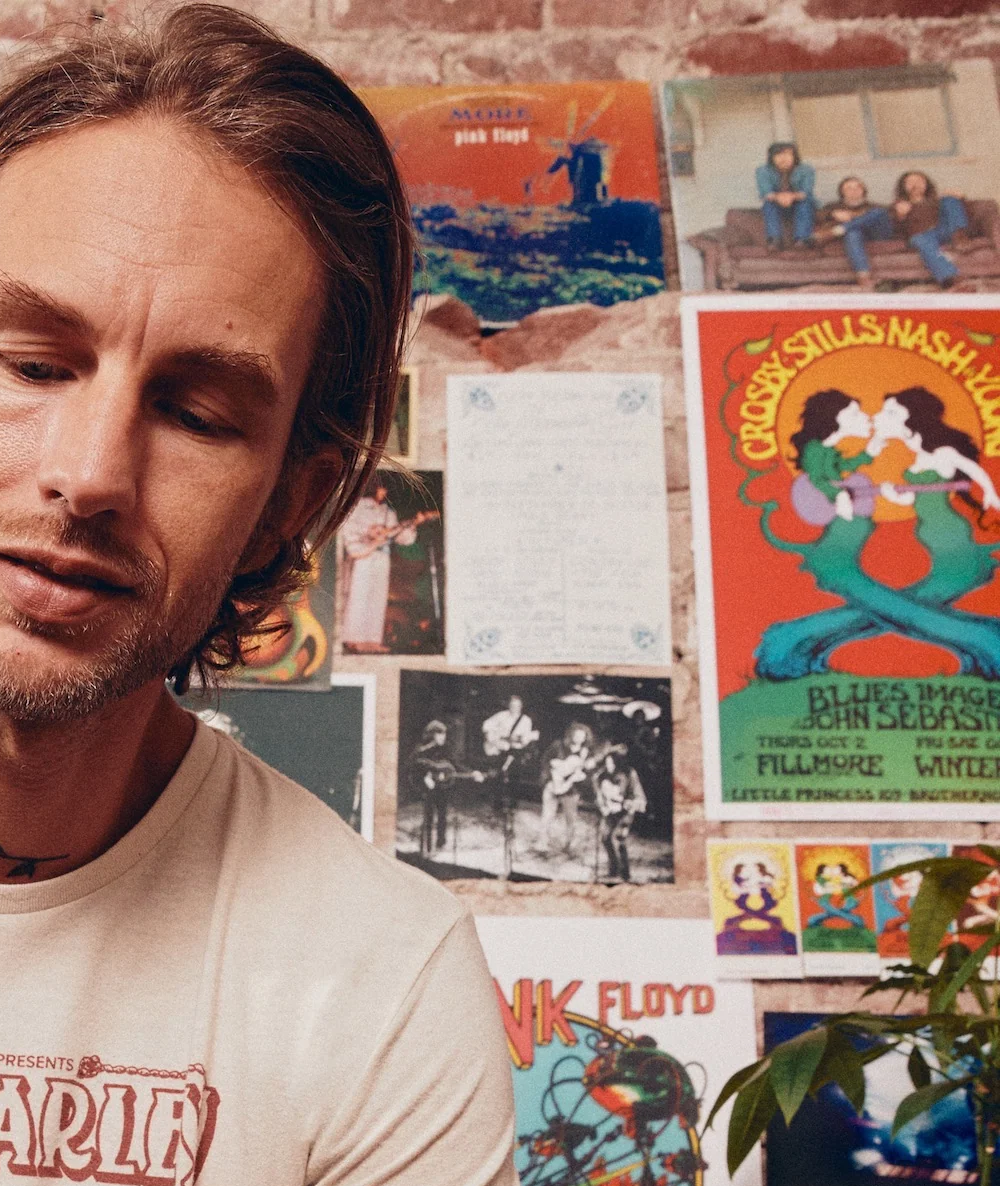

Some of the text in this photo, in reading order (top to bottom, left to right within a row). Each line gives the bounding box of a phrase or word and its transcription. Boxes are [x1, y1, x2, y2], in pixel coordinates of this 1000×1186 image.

[454, 127, 529, 147] pink floyd
[740, 350, 798, 460] CROSBY
[782, 313, 885, 368] STILLS
[887, 315, 978, 376] NASH
[808, 682, 909, 713] BLUES
[757, 753, 884, 778] FILLMORE
[598, 979, 715, 1026] FLOYD
